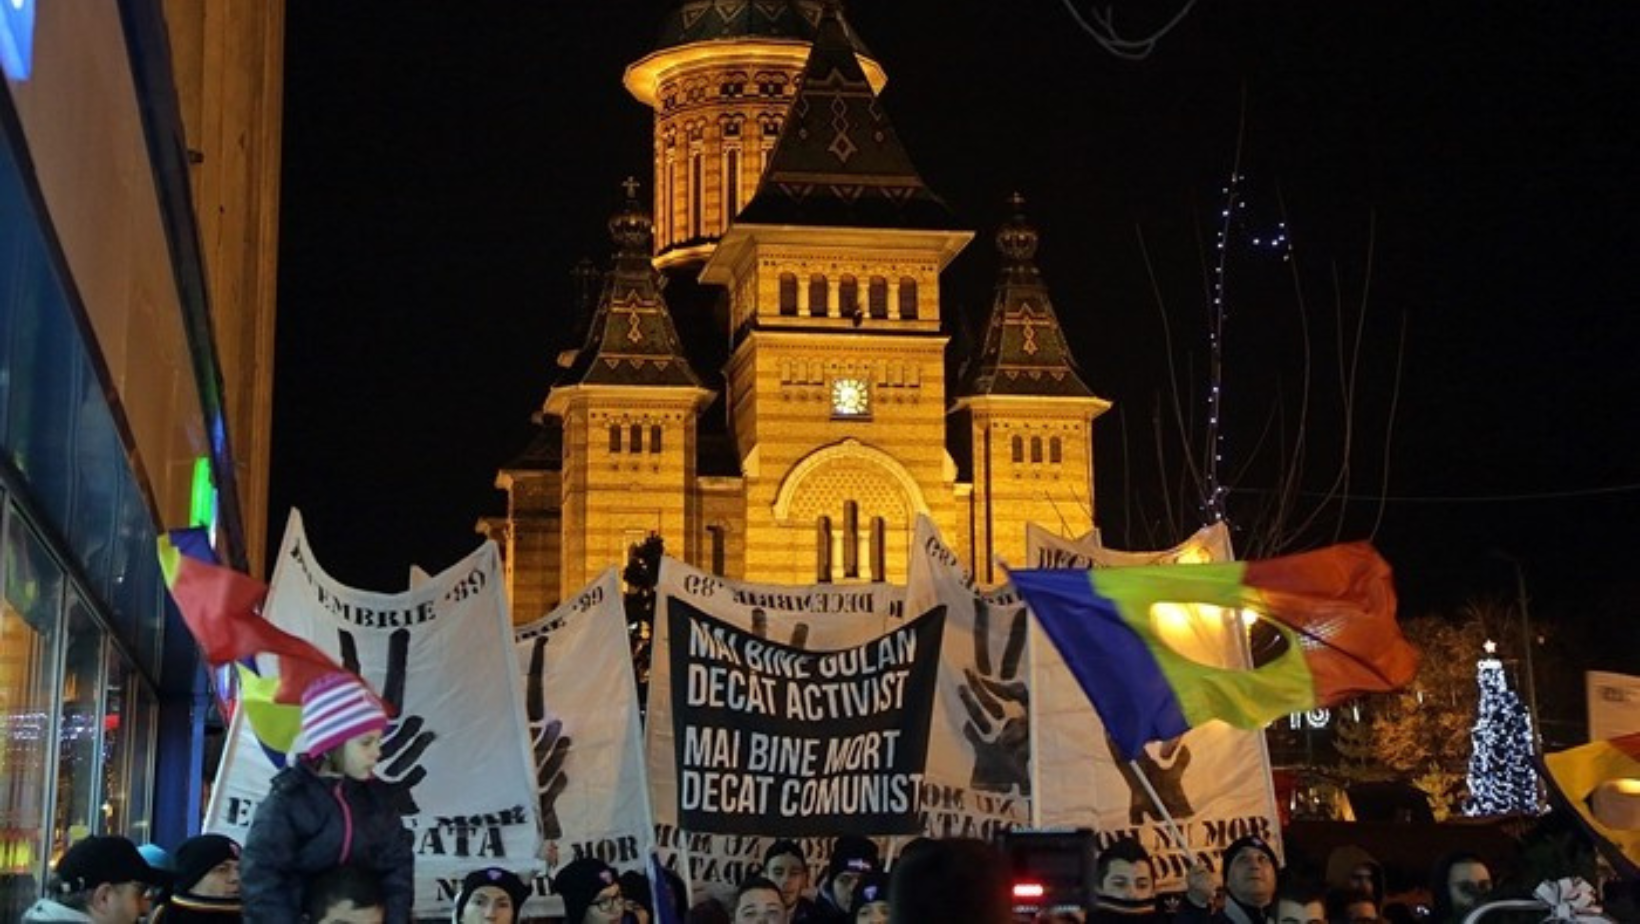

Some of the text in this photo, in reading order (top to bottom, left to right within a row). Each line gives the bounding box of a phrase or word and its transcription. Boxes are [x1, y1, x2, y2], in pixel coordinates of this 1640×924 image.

[445, 568, 486, 603] '89
[689, 616, 741, 666] MAI
[745, 639, 812, 679] BINE
[785, 670, 910, 722] ACTIVIST
[683, 726, 901, 777] MAI BINE MORT
[681, 769, 924, 818] DECAT COMUNIST
[570, 835, 639, 863] MOR
[1203, 815, 1271, 848] MOR
